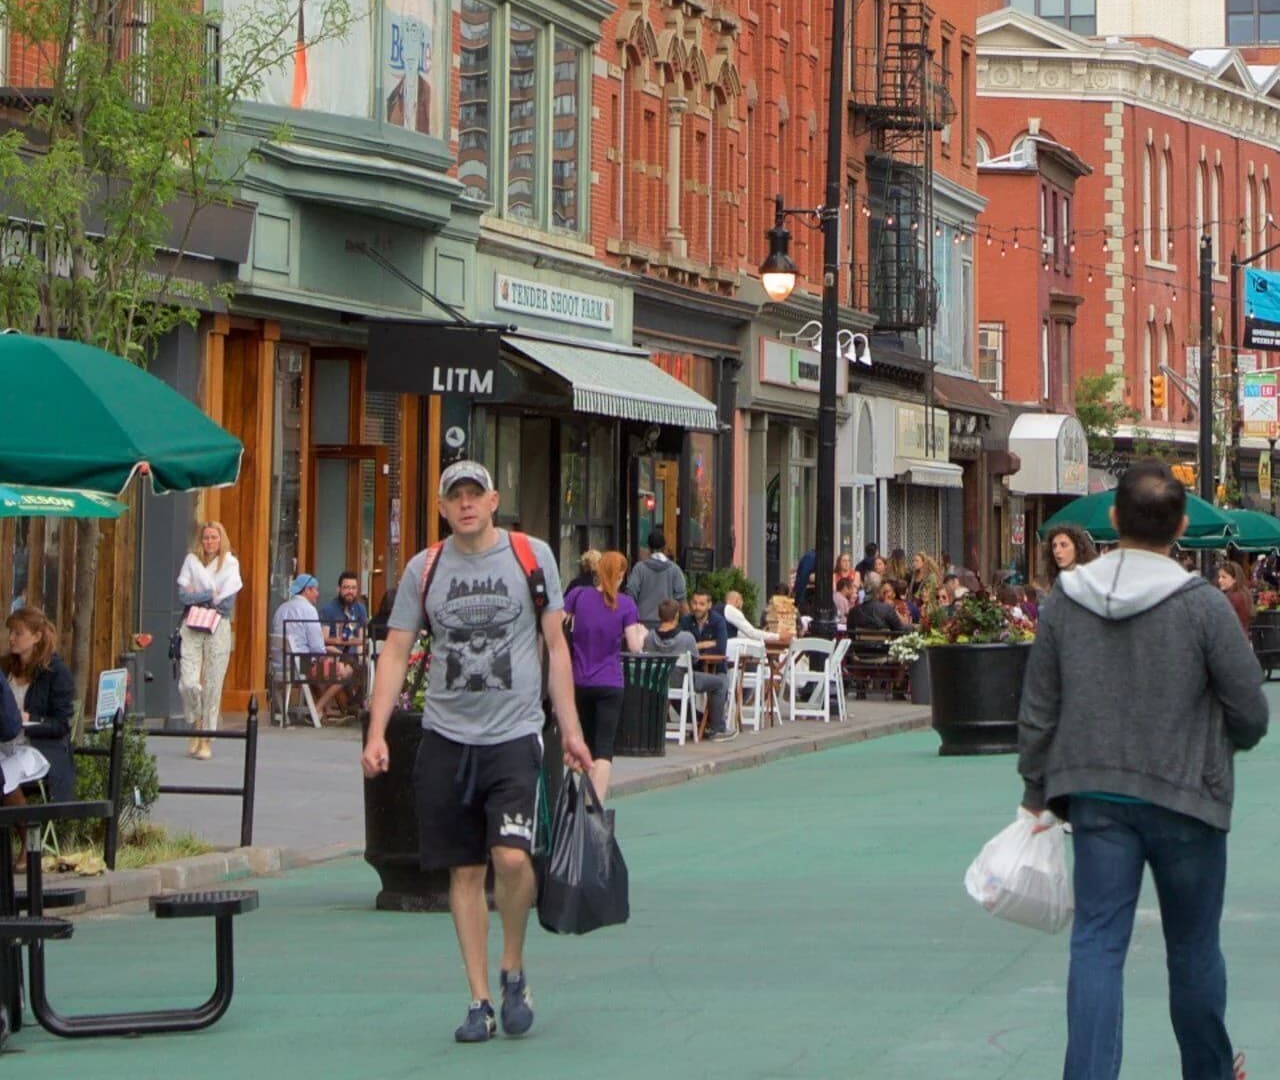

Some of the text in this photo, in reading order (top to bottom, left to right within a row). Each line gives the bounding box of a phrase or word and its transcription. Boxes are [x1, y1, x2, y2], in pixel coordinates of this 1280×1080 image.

[511, 282, 603, 321] TENDER SHOOT FARM
[433, 367, 494, 394] LITM
